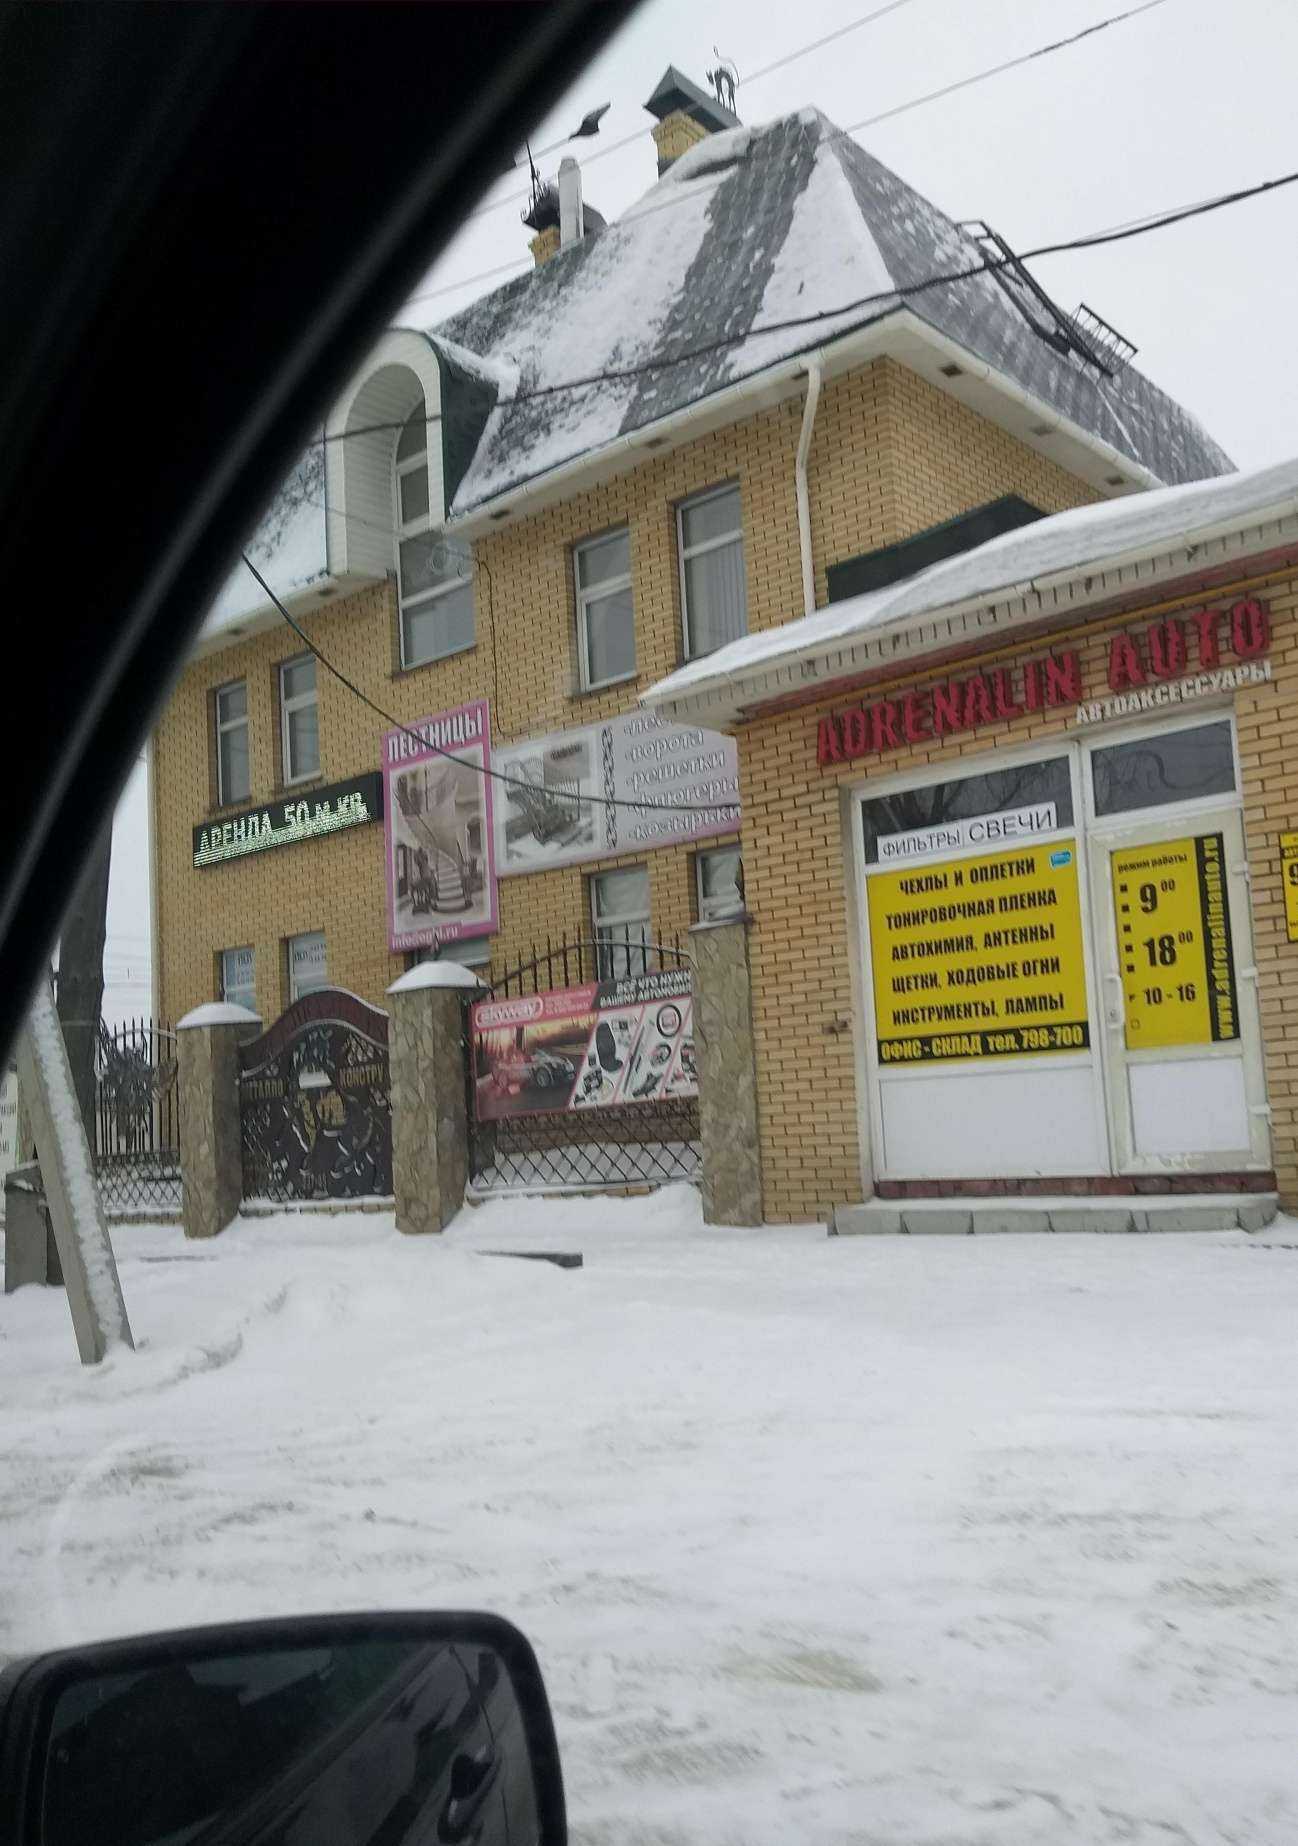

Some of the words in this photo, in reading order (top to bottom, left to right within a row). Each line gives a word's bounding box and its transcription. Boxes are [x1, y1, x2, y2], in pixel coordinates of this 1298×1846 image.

[815, 649, 1081, 766] ADRENALIN
[1108, 599, 1271, 691] AUTO
[1075, 660, 1271, 724] АВТОАКСЕССУАРЫ
[200, 810, 273, 850] АРЕНДА
[883, 831, 960, 857] ФИЛЬТРЫ
[969, 810, 1052, 843] СВЕЧИ
[900, 877, 949, 895] ЧЕХЛЫ
[954, 871, 963, 887] И
[970, 858, 1036, 884] ОПЛЕТКИ
[1151, 854, 1188, 869] работы
[886, 898, 995, 930] ТОНИРОВОЧНАЯ
[999, 888, 1058, 912] ПЛЕНКА
[984, 923, 1055, 949] АНТЕННЫ
[947, 960, 1018, 986] ХОДОВЫЕ
[1022, 956, 1060, 977] ОГНИ
[1005, 993, 1064, 1016] ЛАМПЫ
[1143, 987, 1163, 1005] 10
[1177, 983, 1196, 1002] 16
